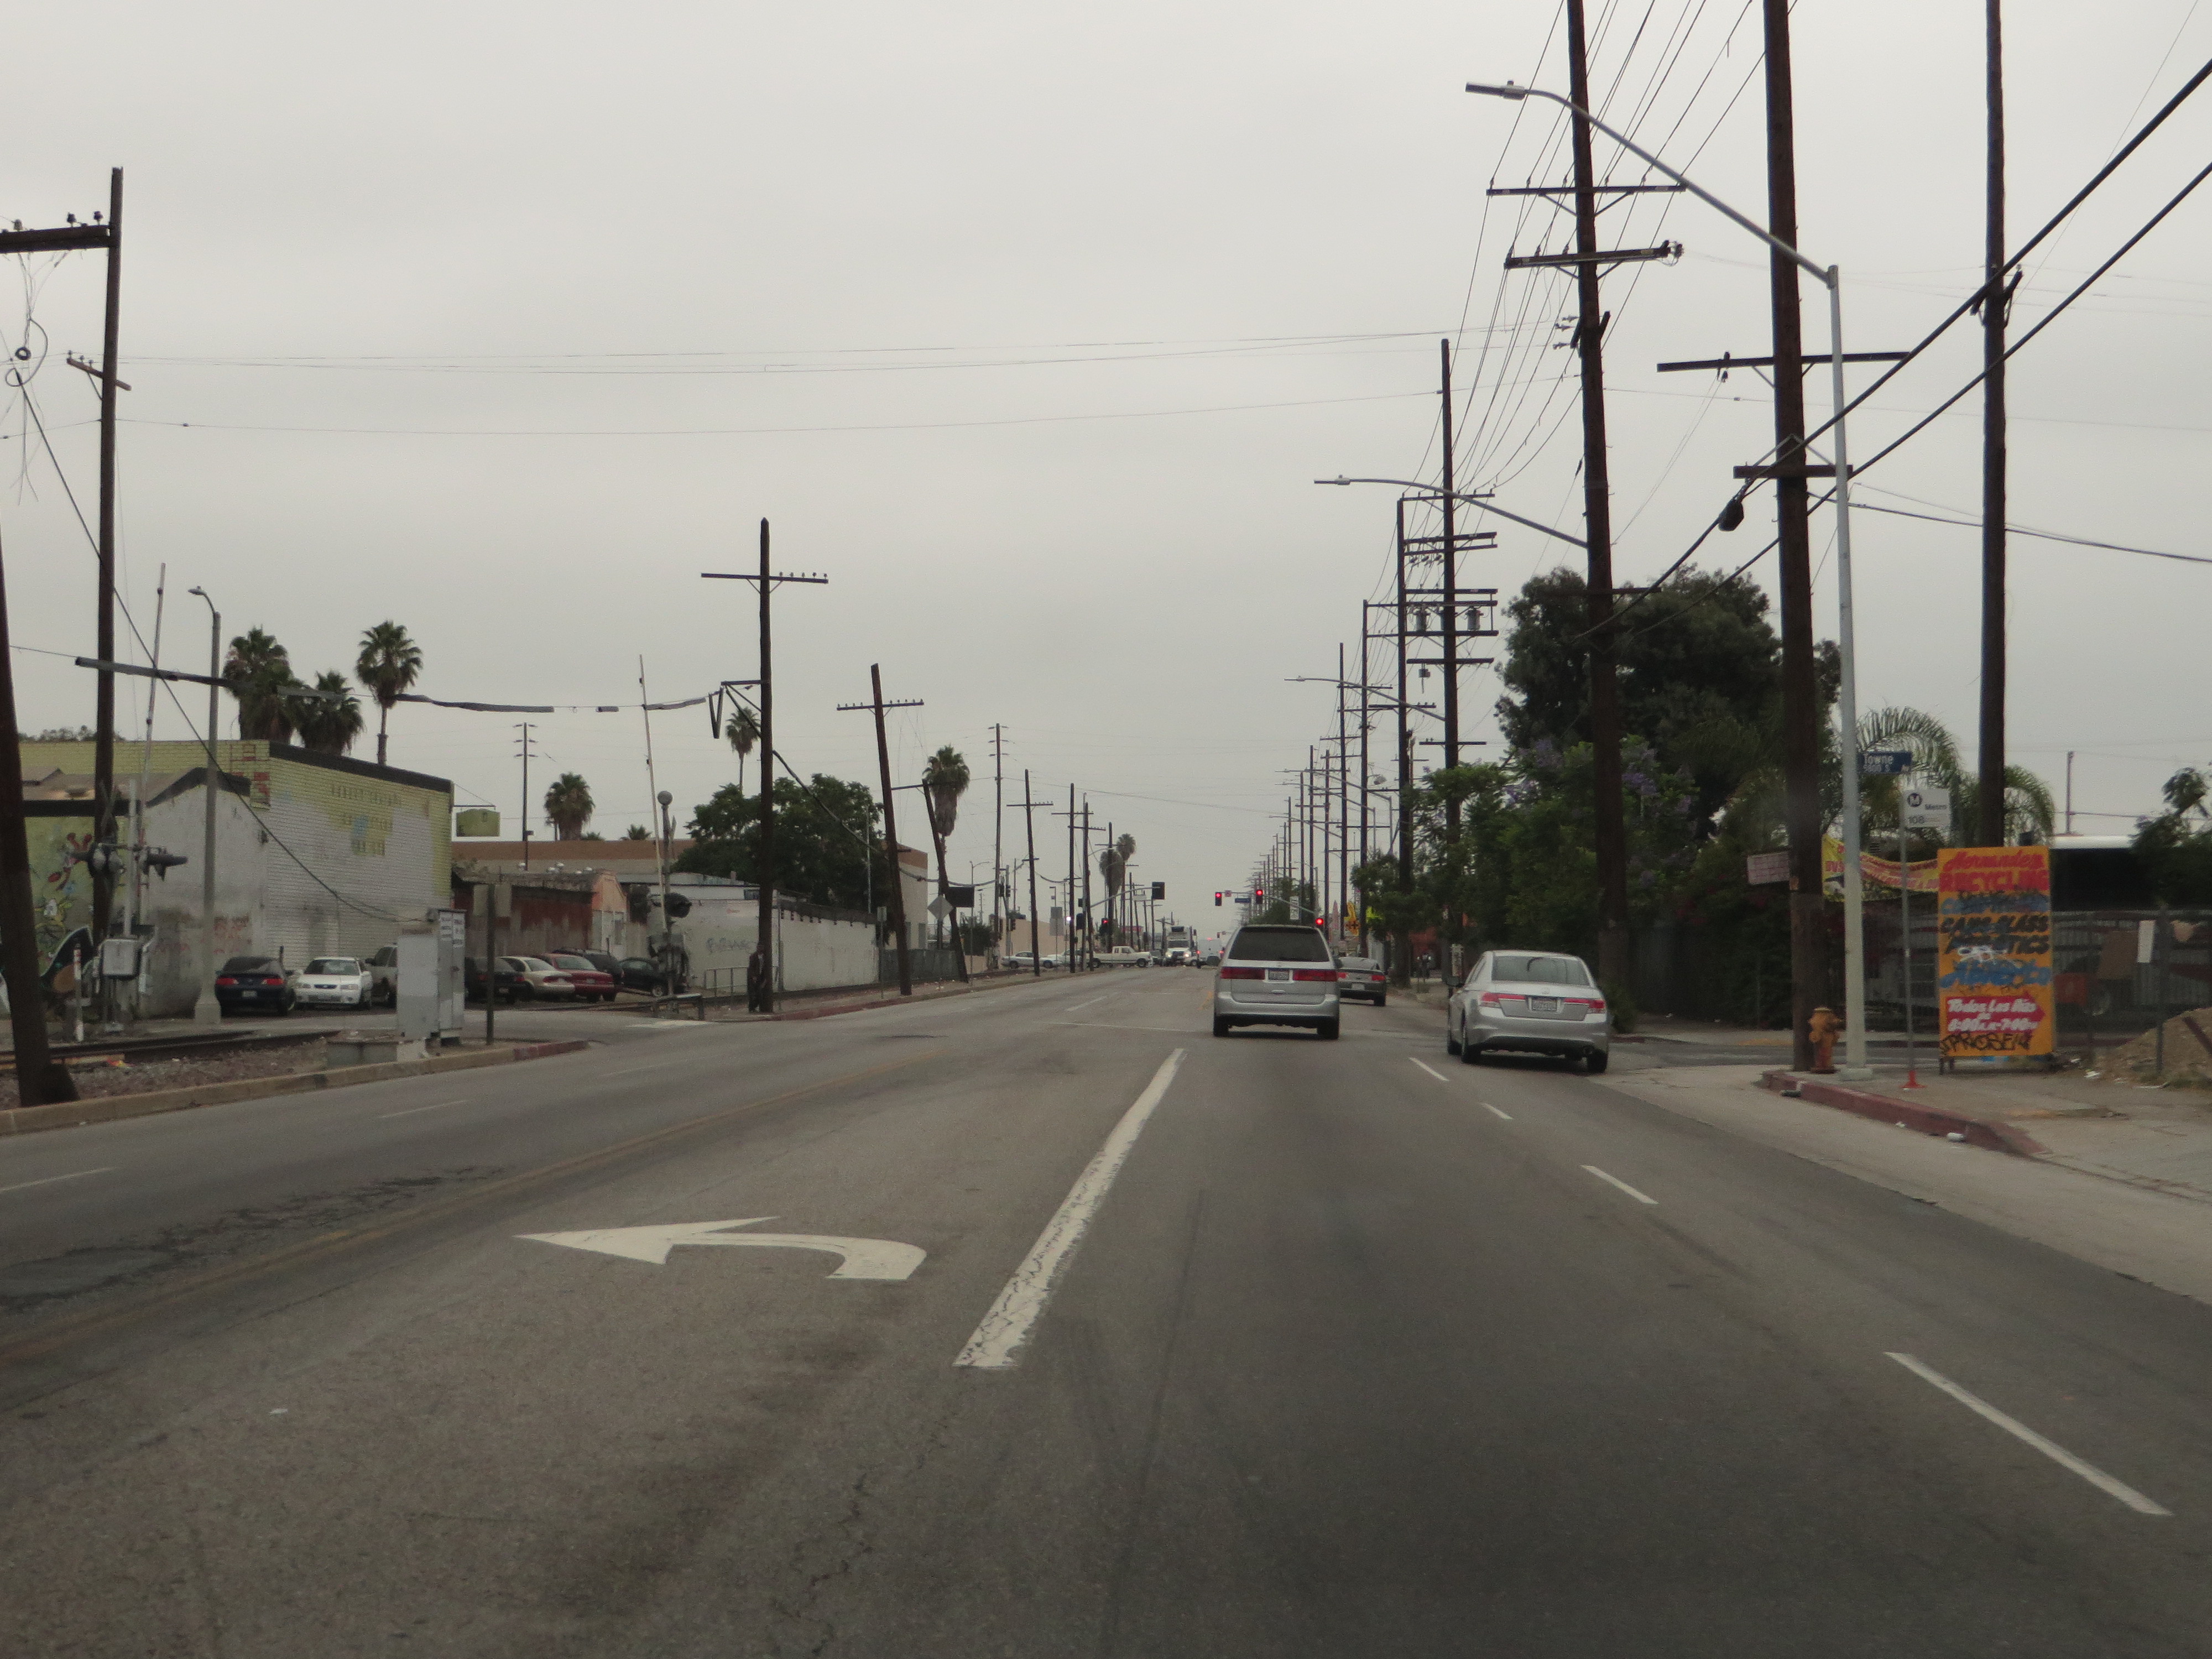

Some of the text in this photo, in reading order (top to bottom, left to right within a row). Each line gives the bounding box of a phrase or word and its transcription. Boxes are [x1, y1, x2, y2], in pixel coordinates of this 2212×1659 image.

[1863, 753, 1893, 764] Towne
[1909, 794, 1921, 806] M
[1908, 816, 1925, 824] 108
[1939, 870, 2049, 892] RECYCLING
[1947, 998, 1987, 1013] Todos
[1988, 999, 2011, 1013] Los
